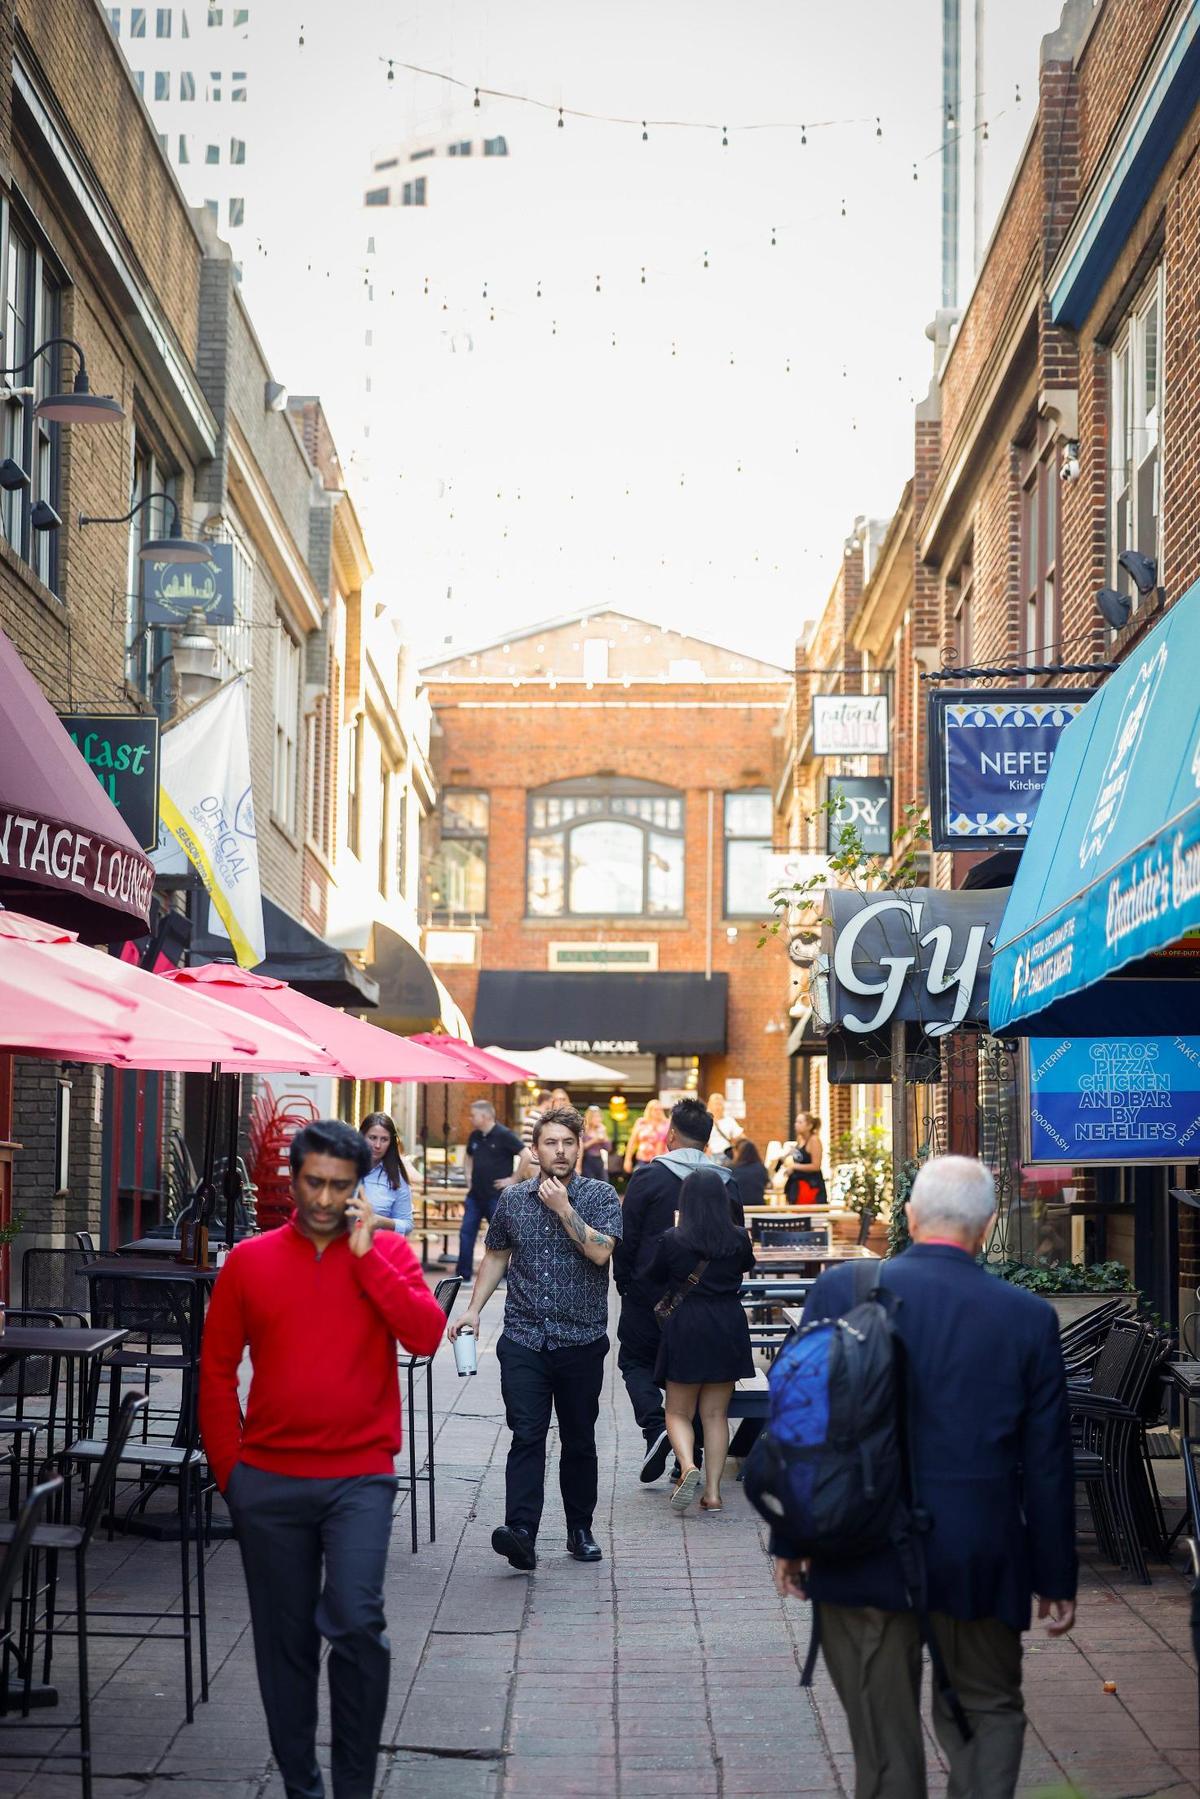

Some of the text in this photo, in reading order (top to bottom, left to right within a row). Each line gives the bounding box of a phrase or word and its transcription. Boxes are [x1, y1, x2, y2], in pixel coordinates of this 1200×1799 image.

[833, 797, 888, 825] DRY
[176, 826, 201, 859] SEASON
[200, 796, 250, 884] OFFICIAL
[834, 899, 997, 1038] Gy
[555, 1040, 639, 1053] LATTA ARCADE
[1089, 1043, 1160, 1060] GYROS
[1172, 1036, 1199, 1063] TAKE
[1031, 1040, 1072, 1082] CATERING
[1095, 1058, 1154, 1075] PIZZA
[1079, 1073, 1171, 1092] CHICKEN
[1079, 1090, 1172, 1108] AND BAR
[1112, 1106, 1141, 1124] BY
[1030, 1109, 1071, 1152] DOORDASH
[1075, 1123, 1177, 1141] NEFELIE'S
